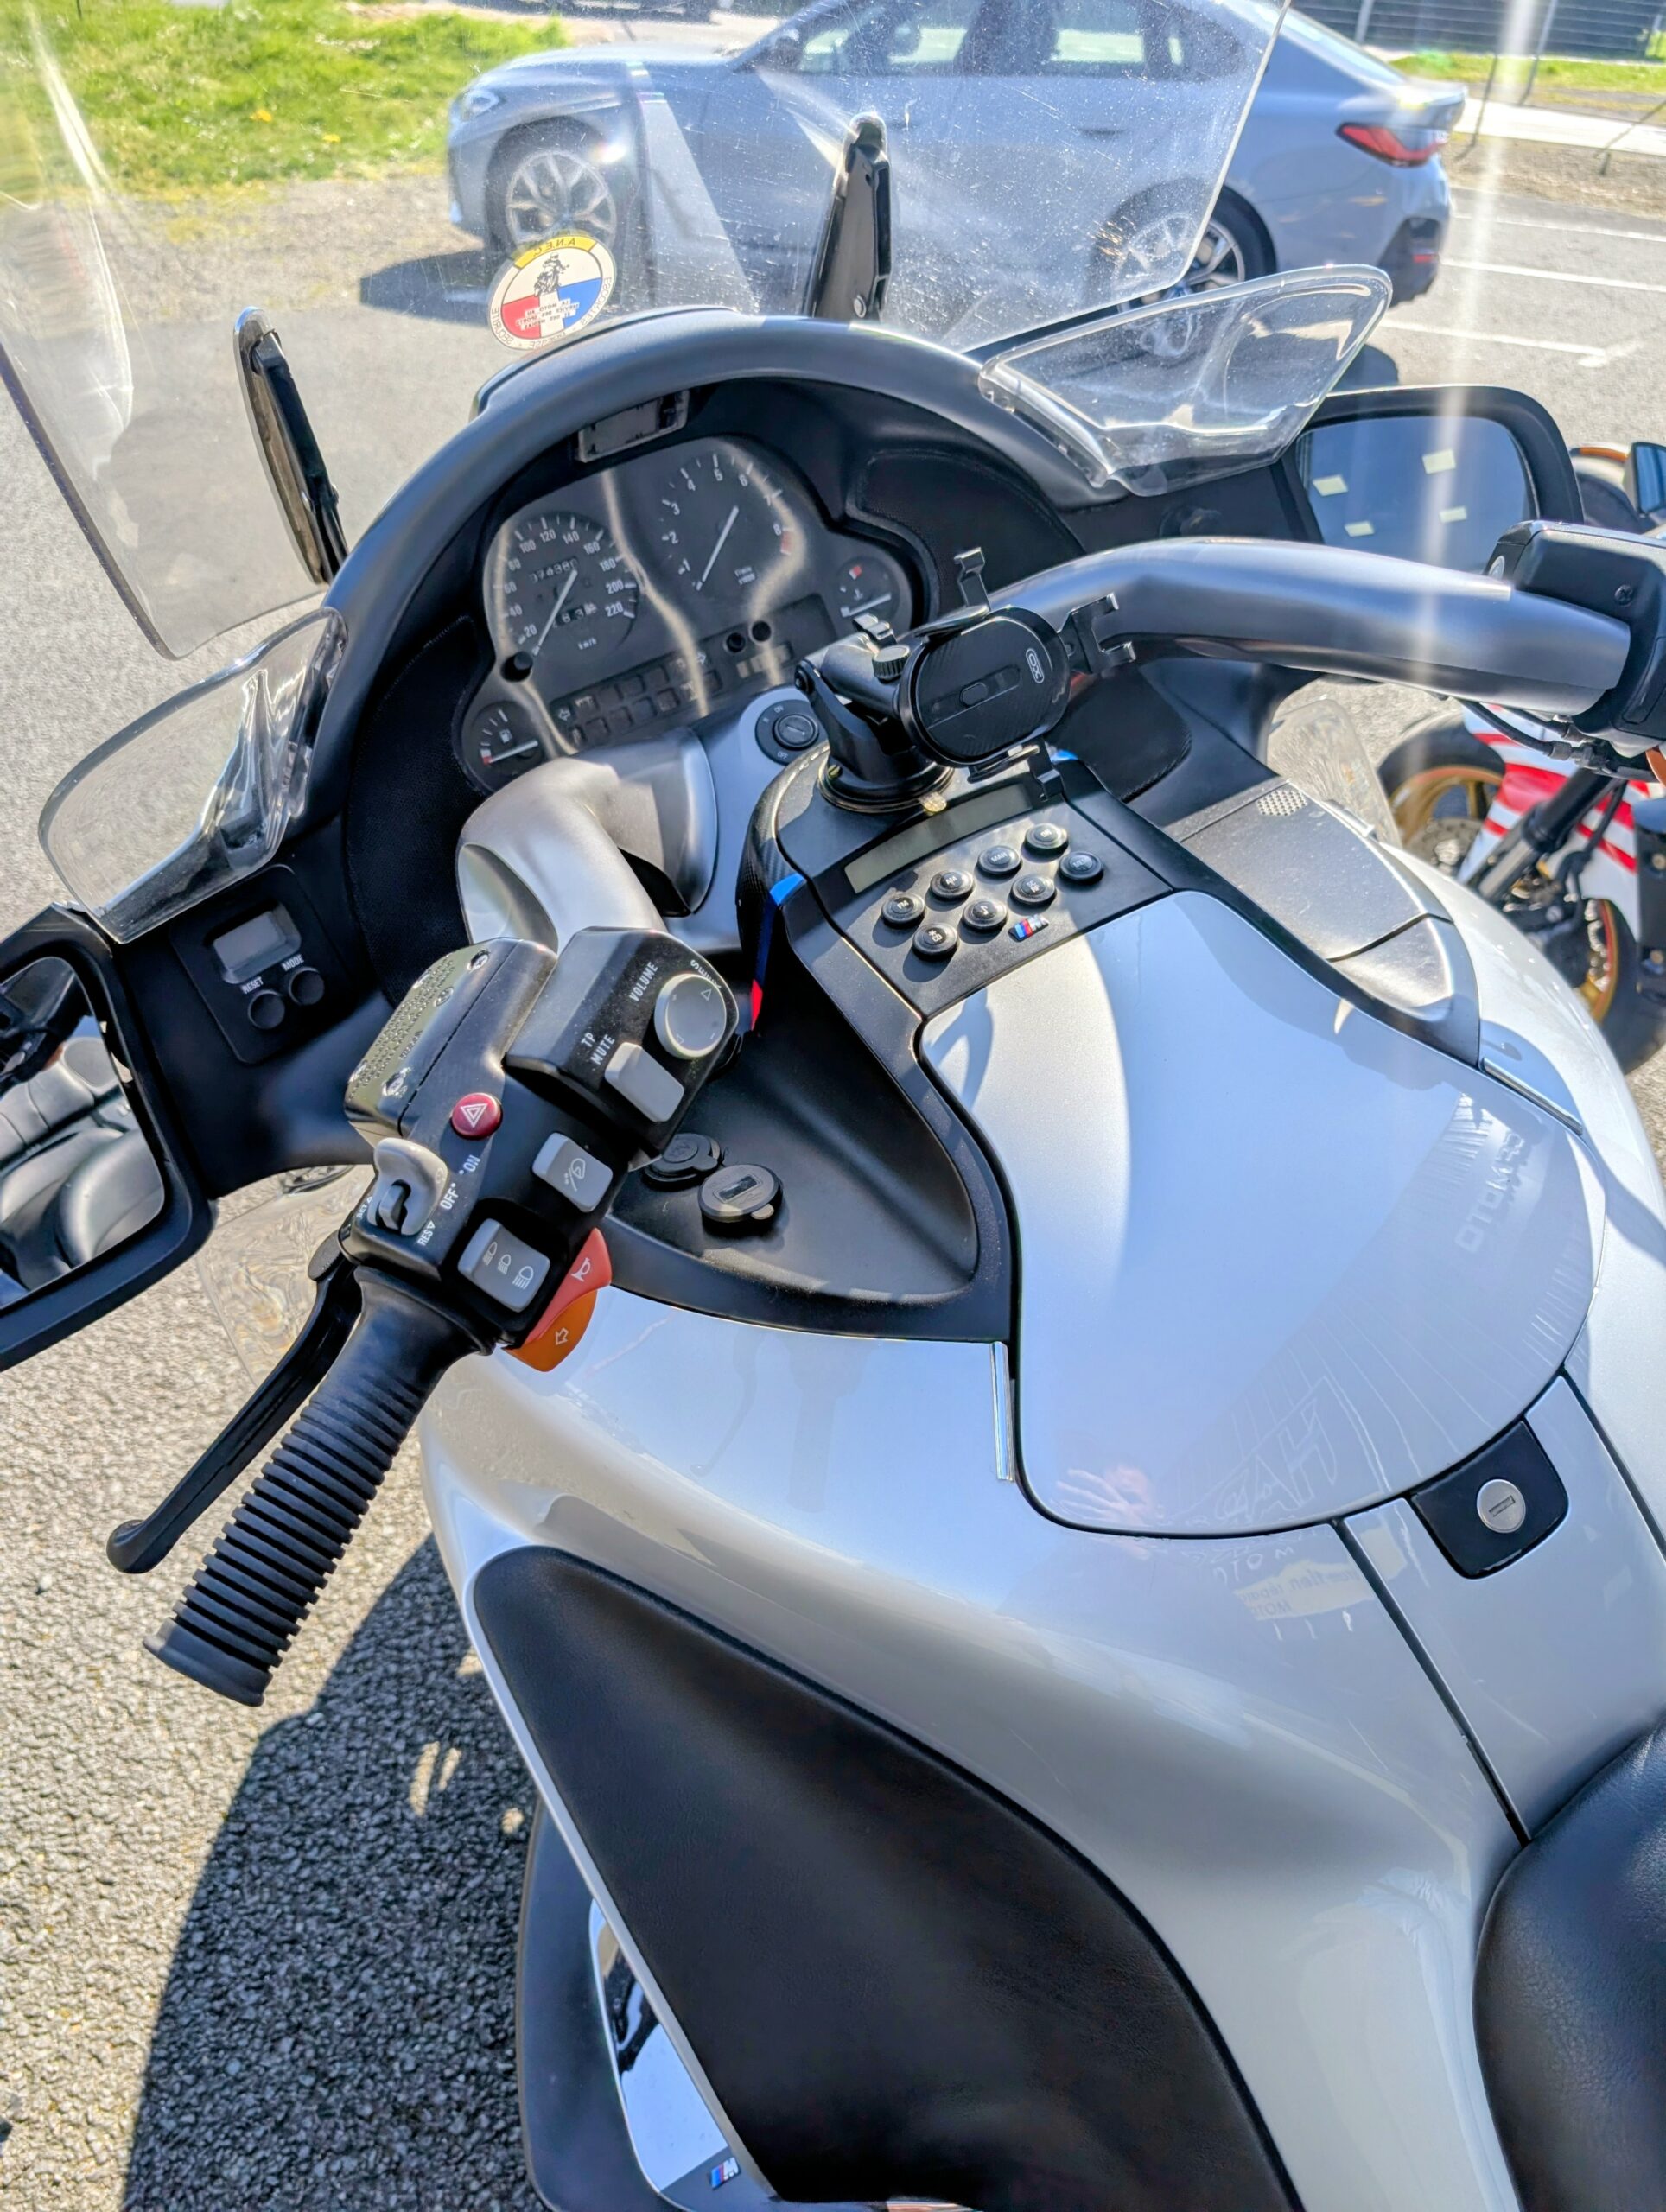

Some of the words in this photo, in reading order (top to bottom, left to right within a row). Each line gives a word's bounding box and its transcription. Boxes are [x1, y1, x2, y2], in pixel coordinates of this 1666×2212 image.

[714, 468, 723, 481] 5
[738, 474, 748, 487] 6
[687, 479, 696, 491] 4
[671, 502, 681, 516] 3
[539, 529, 556, 543] 120
[773, 523, 782, 536] 8
[562, 531, 580, 544] 140
[669, 531, 679, 544] 2
[519, 539, 537, 554] 100
[583, 541, 601, 555] 160
[508, 558, 522, 571] 80
[599, 557, 617, 572] 180
[683, 557, 690, 571] 1
[504, 581, 518, 594] 60
[606, 579, 624, 594] 200
[508, 604, 523, 617] 40
[605, 601, 625, 618] 220
[523, 623, 537, 639] 20
[577, 637, 598, 650] km/h
[777, 751, 789, 760] OFF
[990, 851, 1008, 863] MAN
[897, 899, 910, 910] FM
[932, 932, 943, 942] CD
[281, 954, 305, 972] MODE
[241, 976, 264, 995] RESET
[628, 961, 658, 1002] VOLUME
[581, 1032, 595, 1047] TP
[590, 1034, 615, 1065] MUTE
[463, 1154, 481, 1172] ON
[440, 1187, 459, 1210] OFF
[416, 1230, 435, 1246] RES
